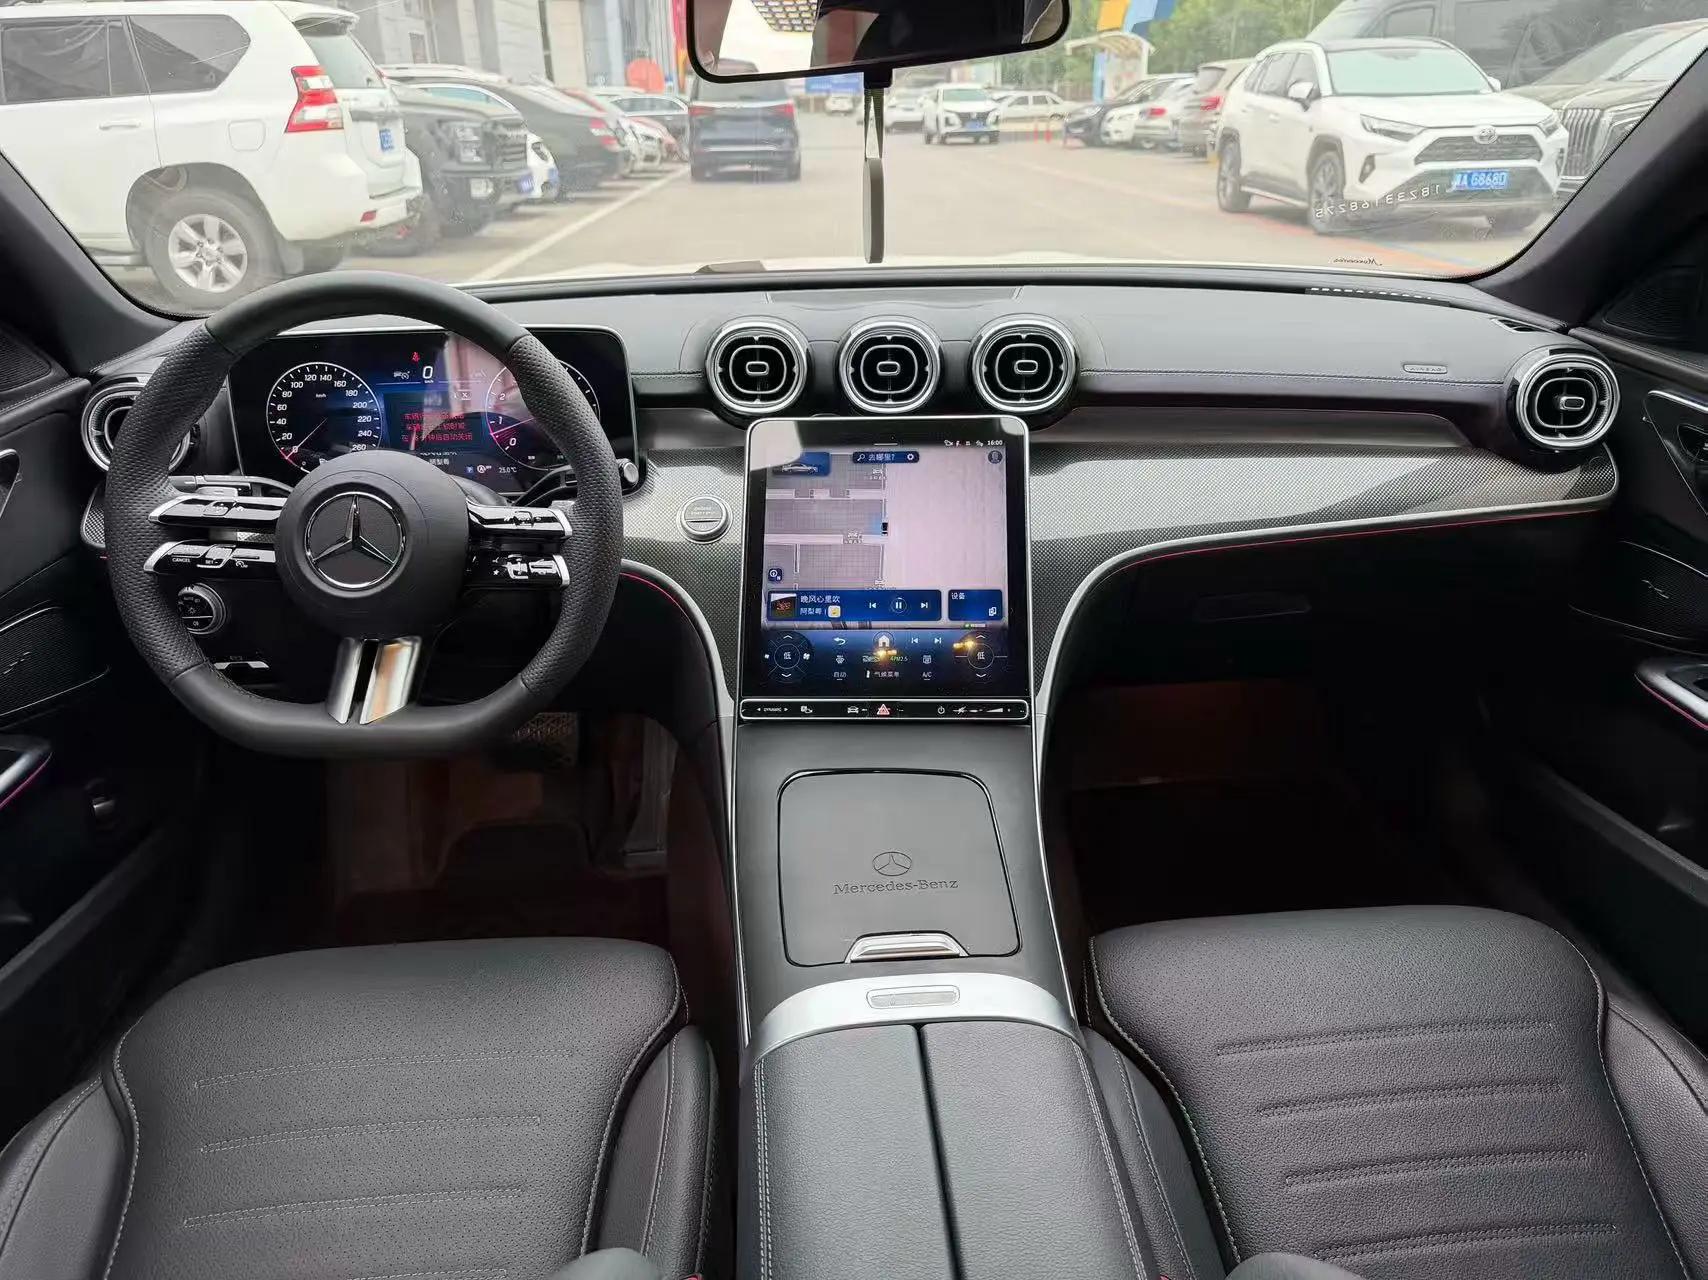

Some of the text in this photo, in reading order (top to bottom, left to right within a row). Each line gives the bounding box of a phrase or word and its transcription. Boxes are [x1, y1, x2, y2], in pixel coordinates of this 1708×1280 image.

[423, 366, 433, 379] 0
[291, 381, 304, 389] 100
[333, 380, 347, 388] 160
[282, 390, 293, 398] 80
[345, 389, 358, 397] 180
[499, 393, 506, 401] 2
[357, 415, 372, 423] 220
[498, 416, 503, 425] 1
[281, 432, 293, 440] 20
[509, 438, 516, 446] 0
[976, 651, 985, 660] 低
[833, 879, 959, 895] Mercedes-Benz
